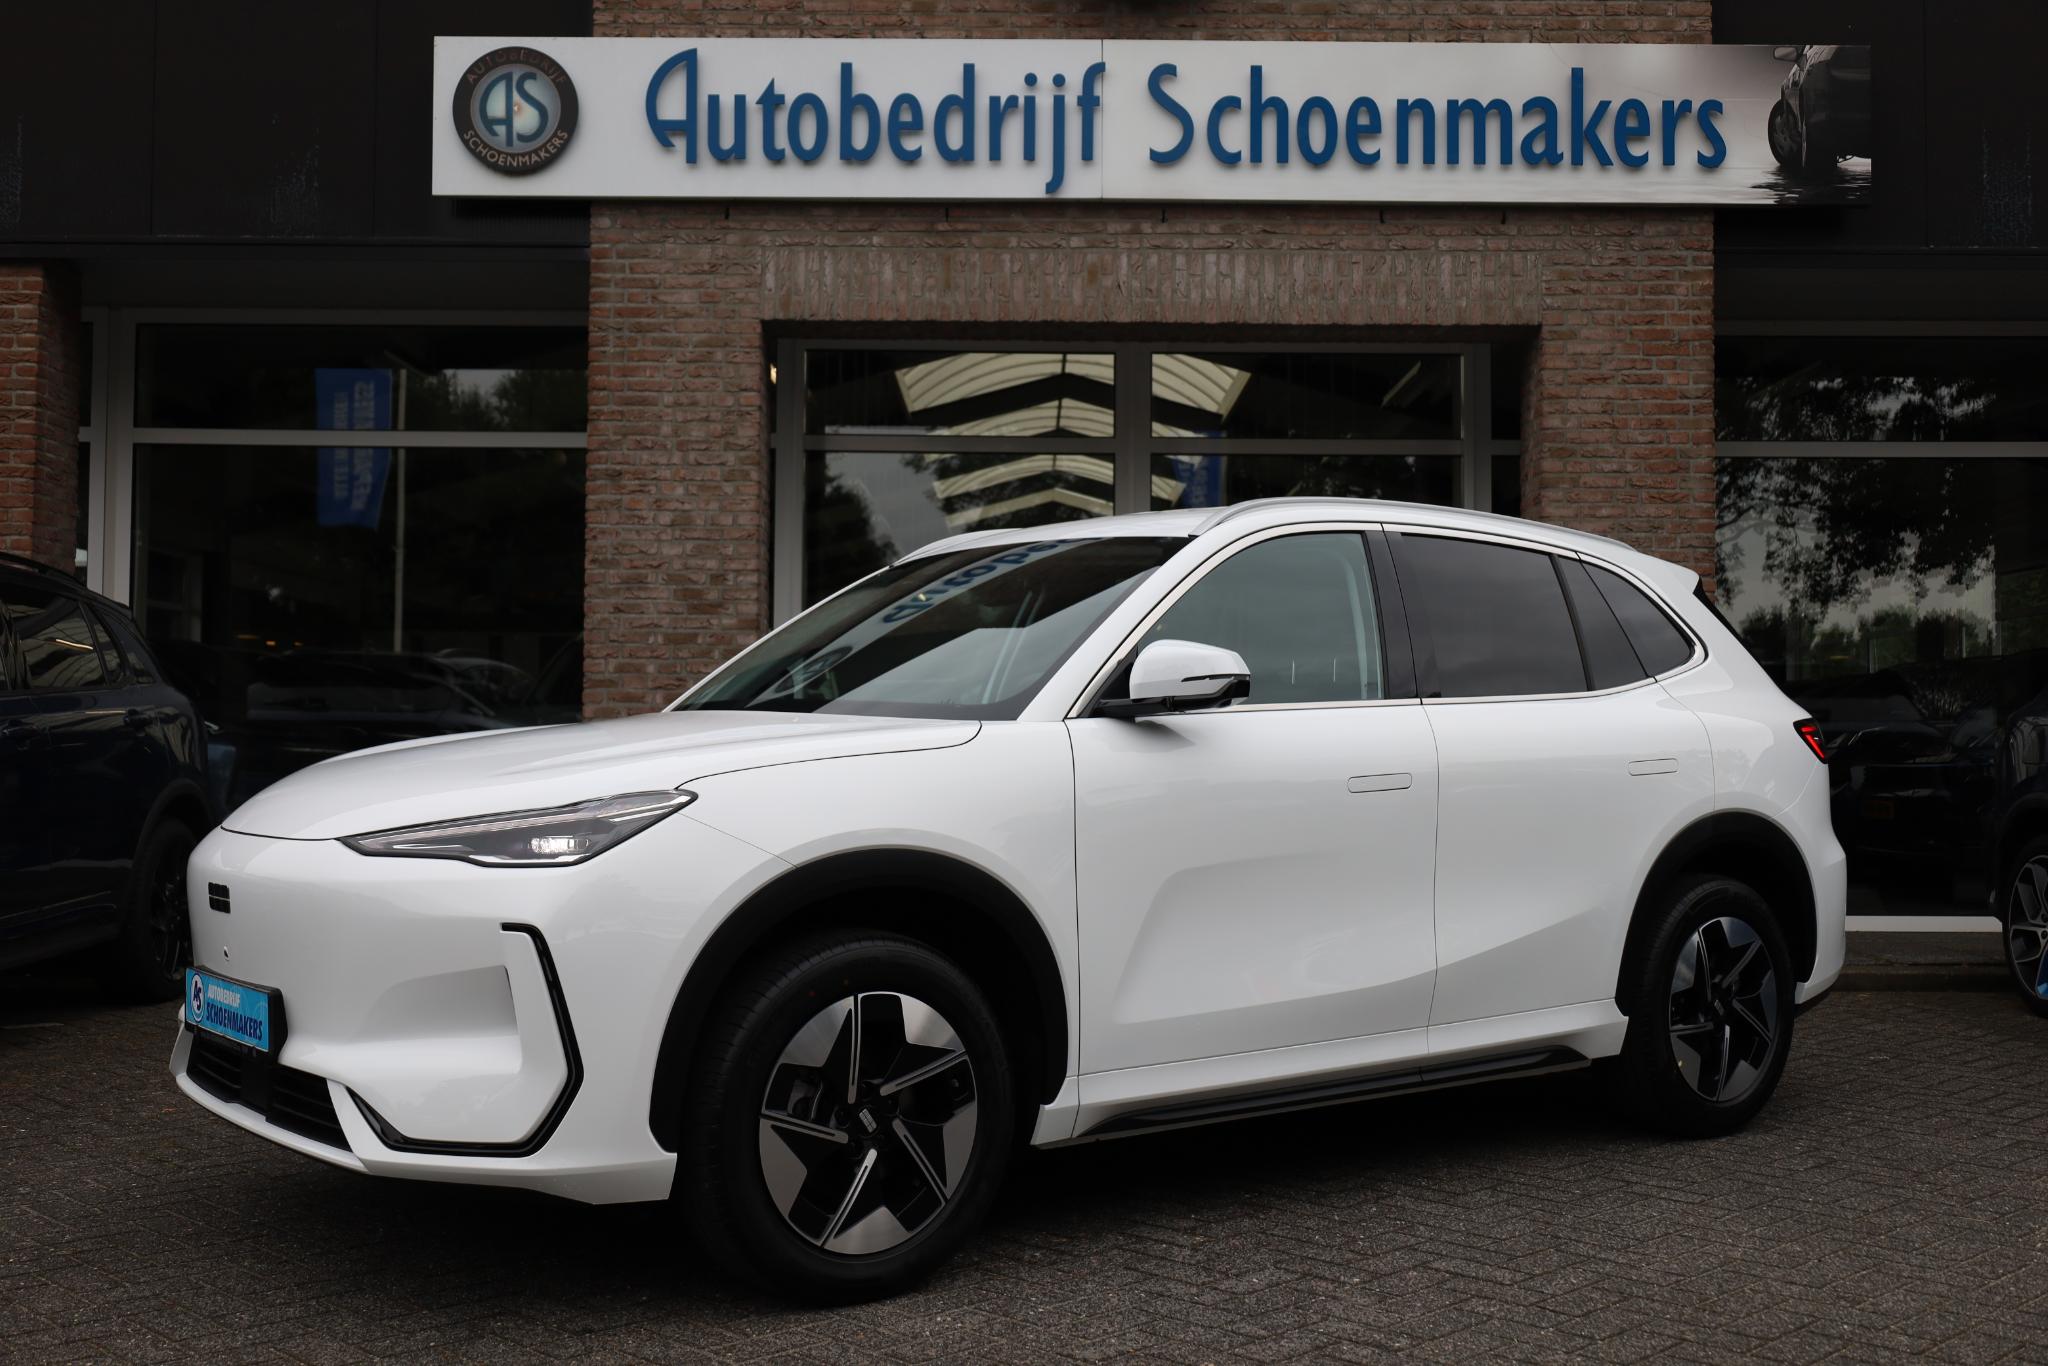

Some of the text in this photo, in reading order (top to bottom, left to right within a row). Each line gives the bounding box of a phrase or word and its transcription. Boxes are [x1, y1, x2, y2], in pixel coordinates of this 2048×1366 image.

[479, 71, 549, 147] AS
[645, 48, 1727, 195] Autobedrijf Schoenmakers
[463, 129, 569, 168] SCHOENMAKERS
[192, 980, 202, 1011] AS
[206, 1002, 263, 1041] SCHOENMAKERS
